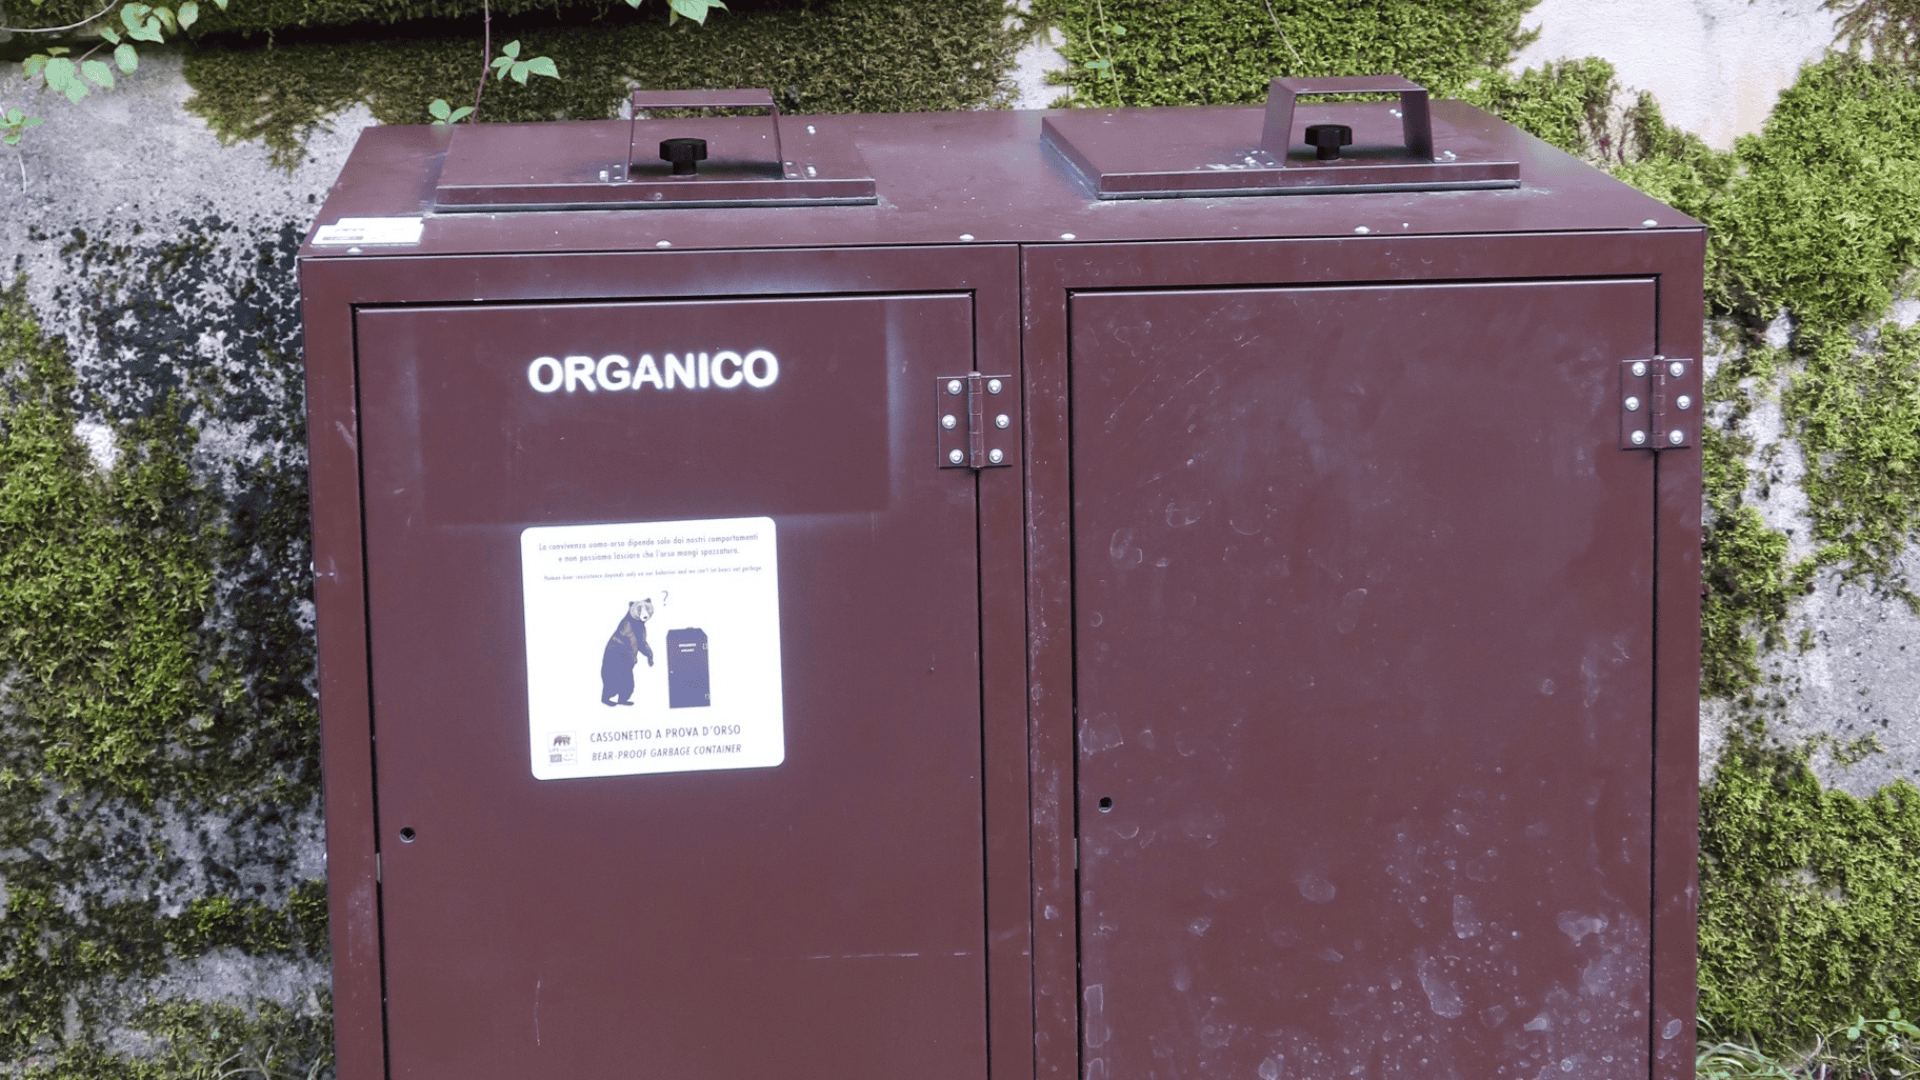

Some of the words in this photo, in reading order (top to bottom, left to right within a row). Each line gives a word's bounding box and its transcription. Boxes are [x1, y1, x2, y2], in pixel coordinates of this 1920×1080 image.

[528, 350, 779, 392] ORGANICO
[539, 542, 547, 551] La
[549, 542, 586, 551] convivenza
[627, 538, 655, 548] dipende
[657, 537, 671, 545] solo
[673, 536, 684, 545] dai
[686, 535, 706, 544] nostri
[708, 532, 759, 543] comportamenti
[579, 553, 612, 563] possiamo
[613, 551, 641, 560] lasciare
[642, 550, 655, 559] che
[656, 549, 675, 558] l'orso
[677, 548, 698, 558] mangi
[661, 590, 669, 606] ?
[590, 729, 652, 743] CASSONETTO
[655, 729, 662, 739] A
[665, 727, 699, 738] PROVA
[702, 724, 741, 736] D'ORSO
[592, 749, 647, 761] BEAR-PROOF
[650, 746, 690, 758] GARBAGE
[694, 744, 742, 755] CONTAINER
